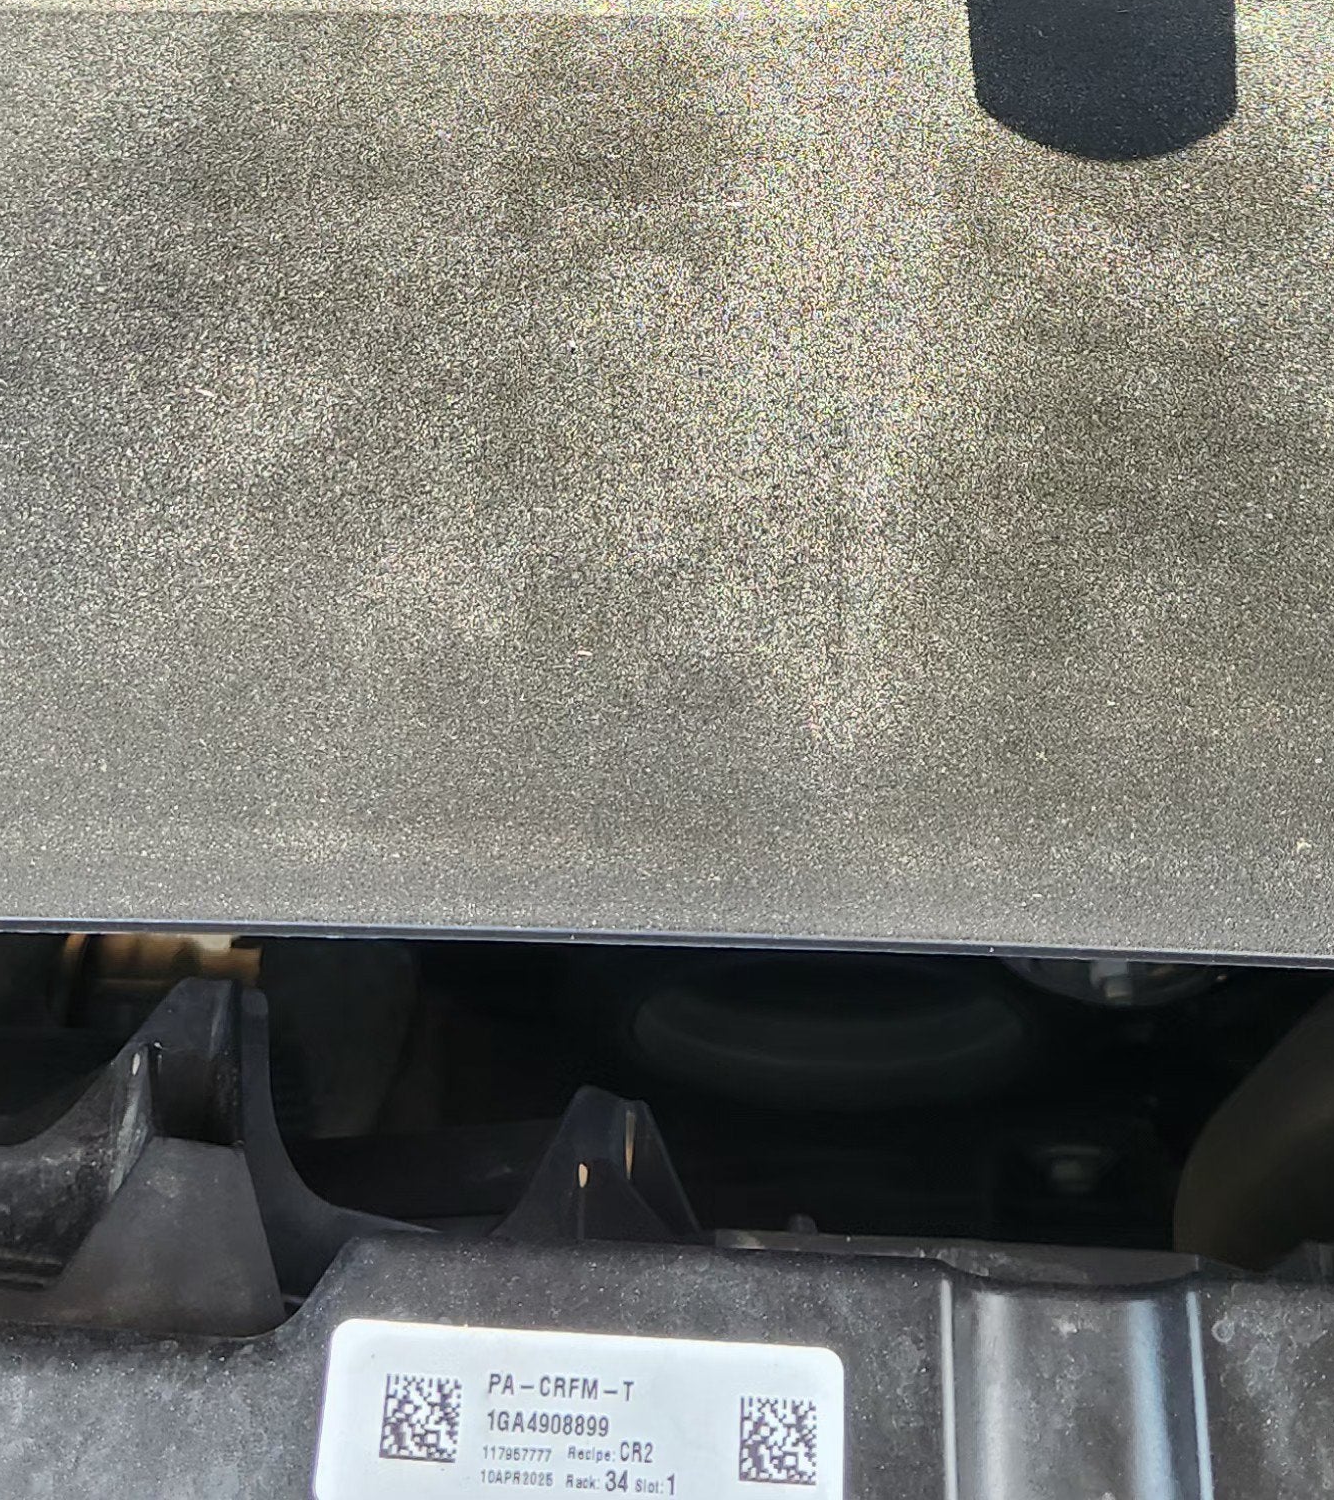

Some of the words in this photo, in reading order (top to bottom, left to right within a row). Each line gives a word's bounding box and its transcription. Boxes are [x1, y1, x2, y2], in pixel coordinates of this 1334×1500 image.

[487, 1409, 609, 1437] 1GA4908899
[567, 1445, 616, 1463] Recipe:
[620, 1441, 653, 1463] CR2
[566, 1474, 600, 1489] Rack:
[605, 1469, 628, 1492] 34
[635, 1478, 664, 1494] Slot:
[667, 1473, 675, 1495] 1
